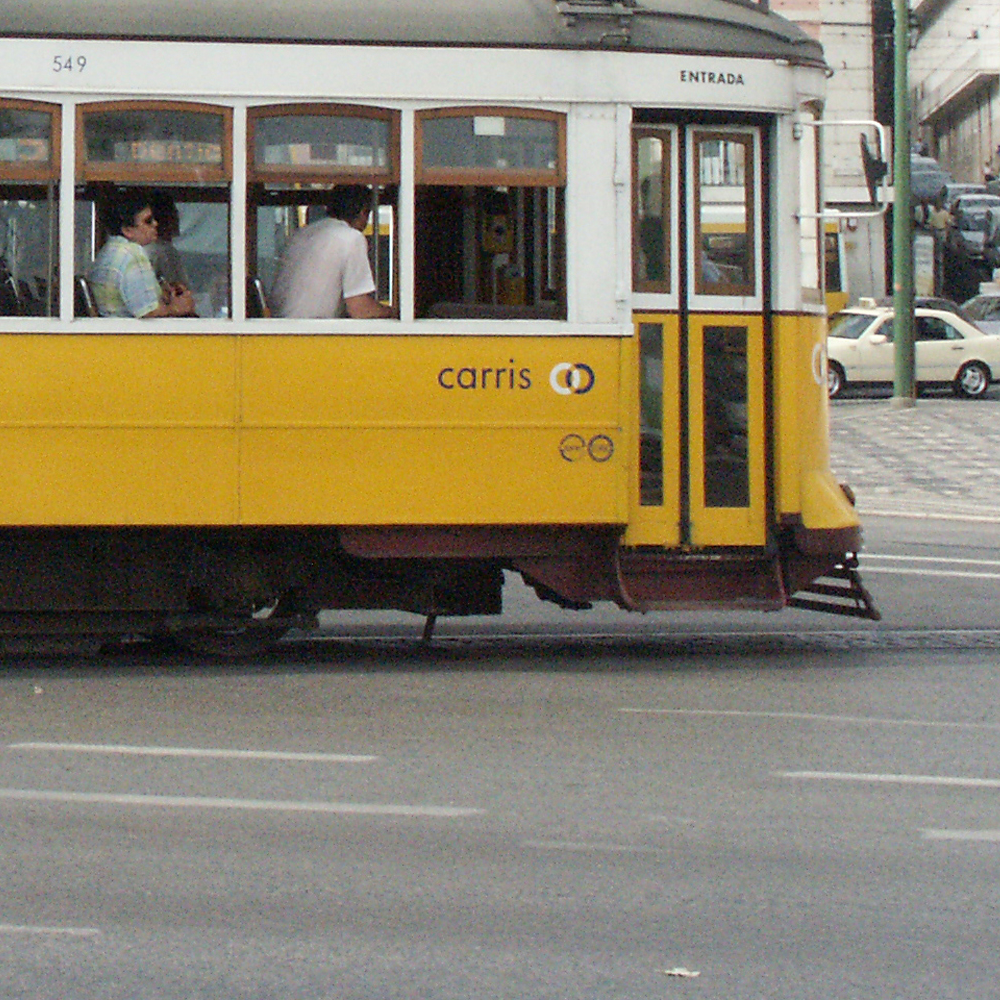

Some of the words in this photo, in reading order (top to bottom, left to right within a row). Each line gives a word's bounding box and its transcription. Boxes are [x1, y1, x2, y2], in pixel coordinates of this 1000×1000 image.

[52, 55, 87, 72] 549
[679, 70, 744, 86] ENTRADA
[438, 358, 532, 390] carris
